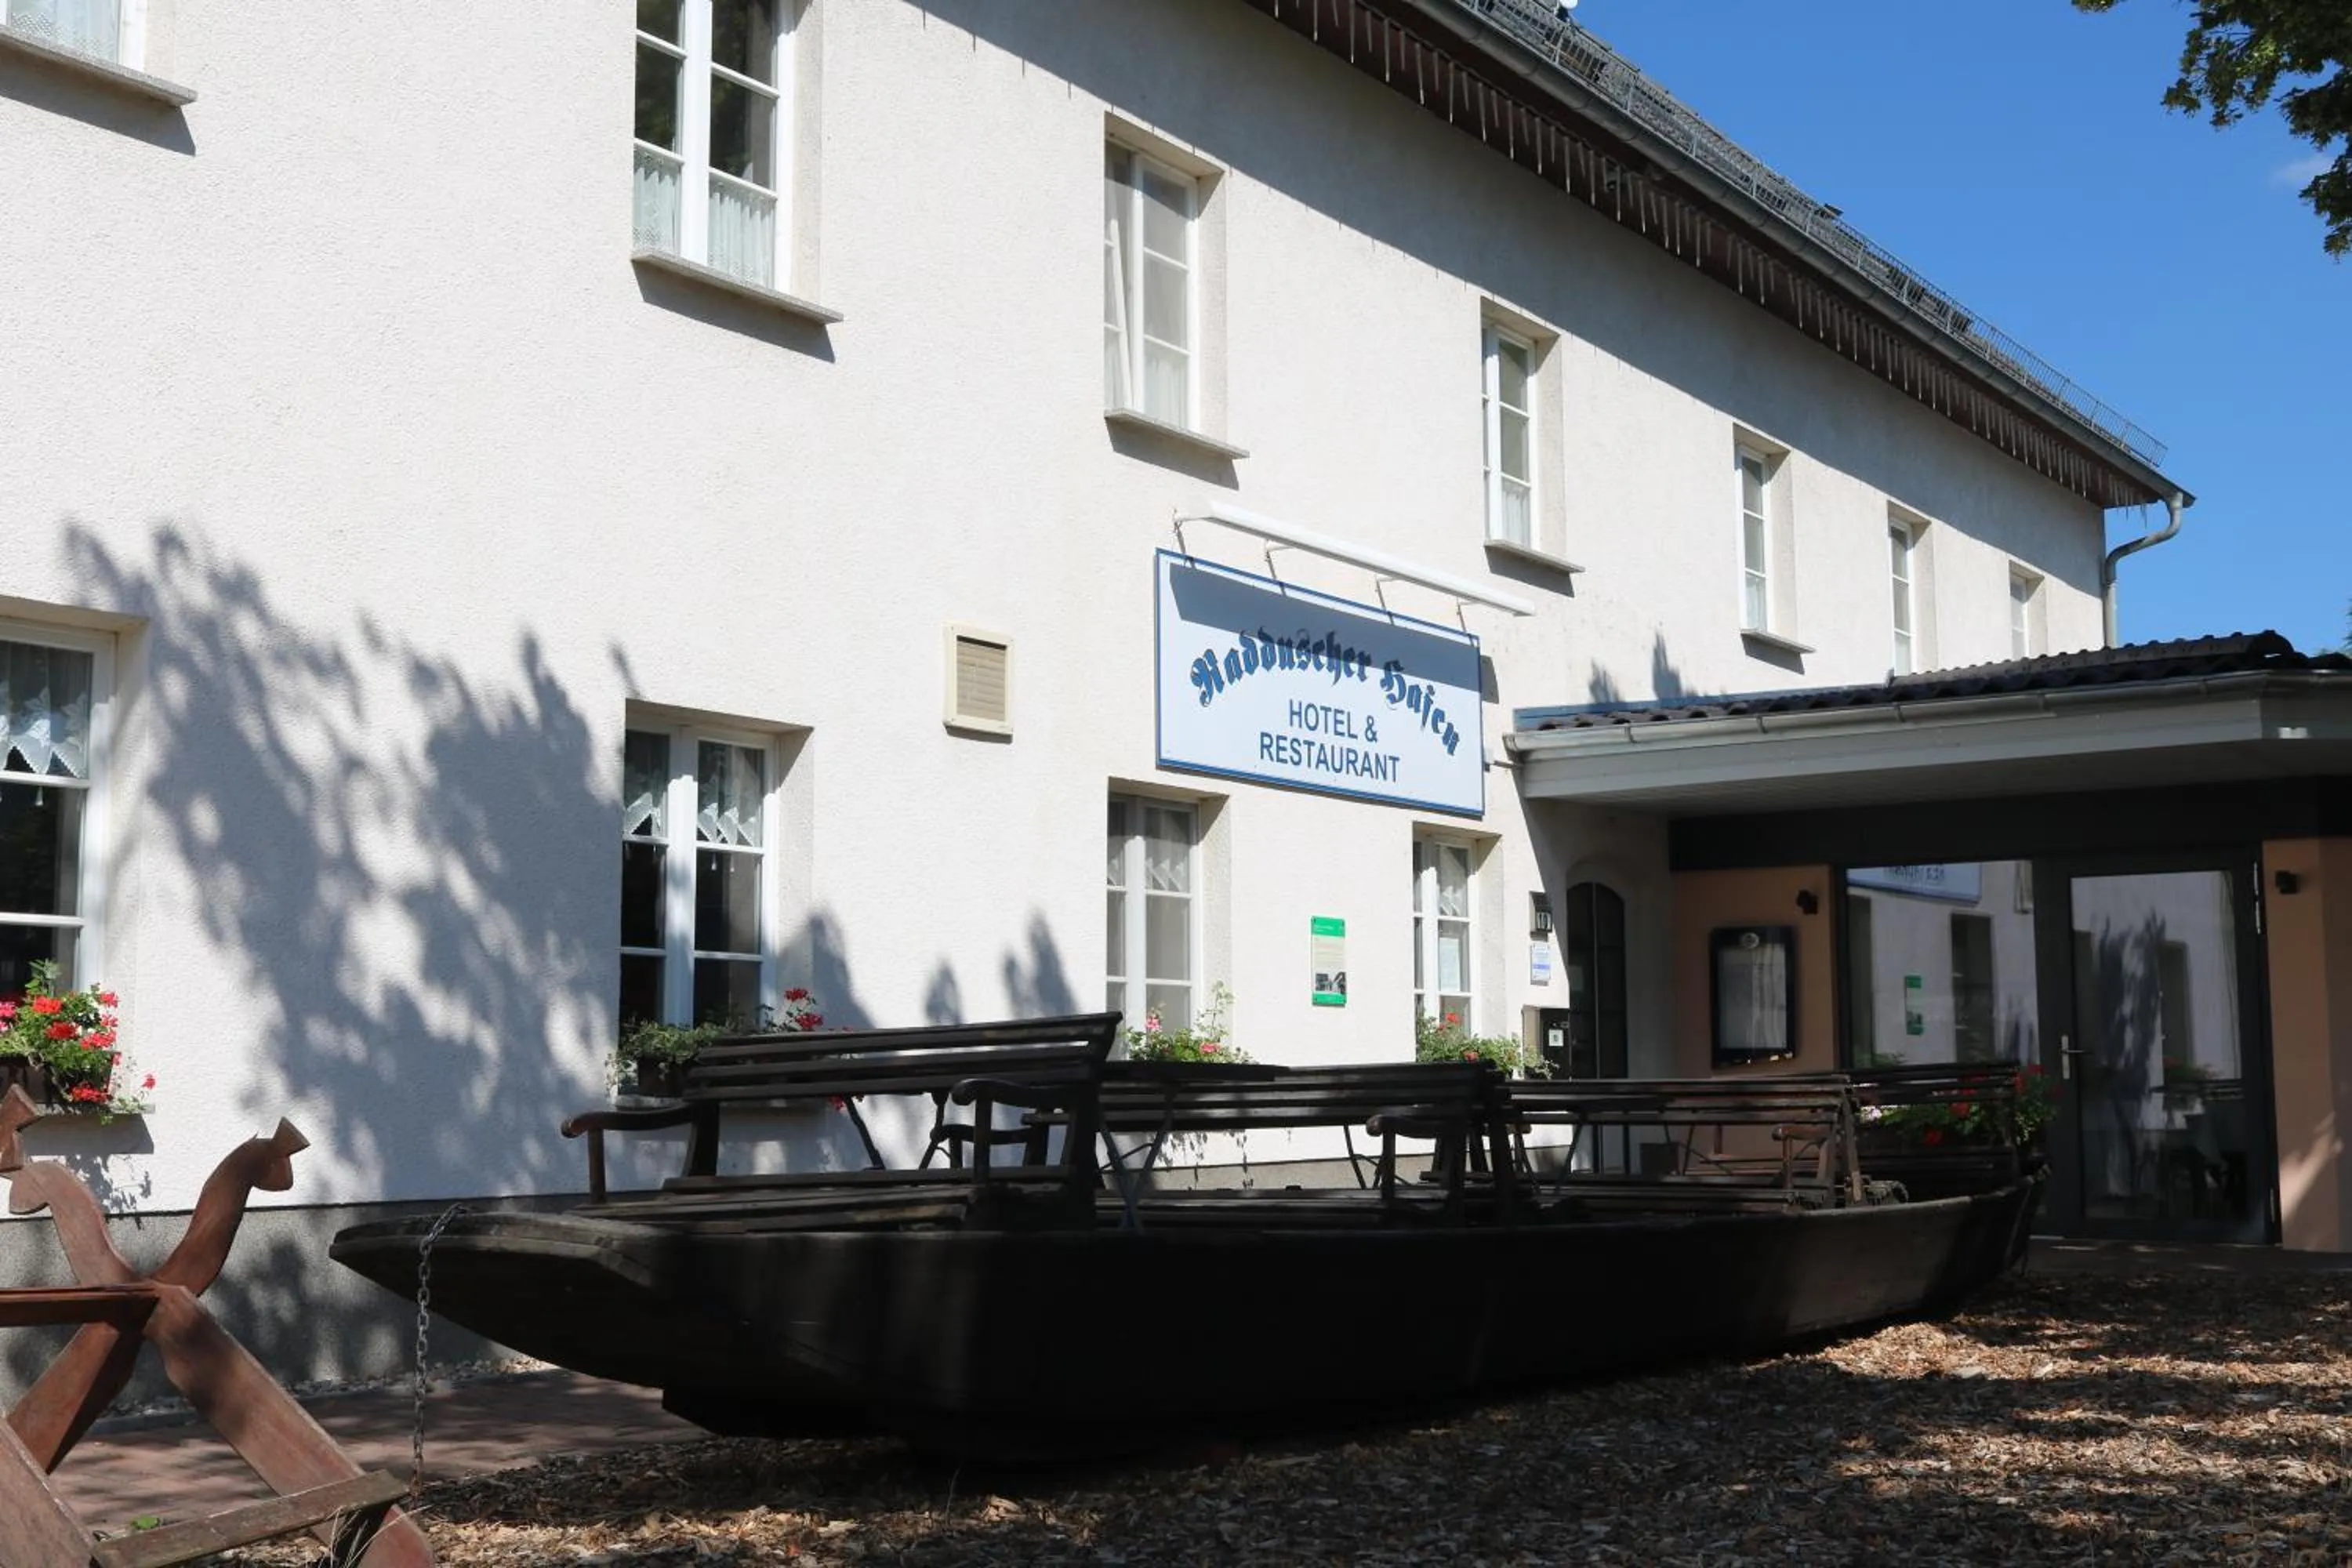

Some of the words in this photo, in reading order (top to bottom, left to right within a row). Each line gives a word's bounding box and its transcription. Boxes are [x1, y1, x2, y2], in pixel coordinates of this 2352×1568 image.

[1190, 627, 1371, 707] Radduscher
[1380, 659, 1460, 757] Hafen
[1289, 699, 1358, 740] HOTEL
[1365, 714, 1378, 743] &
[1259, 731, 1400, 783] RESTAURANT
